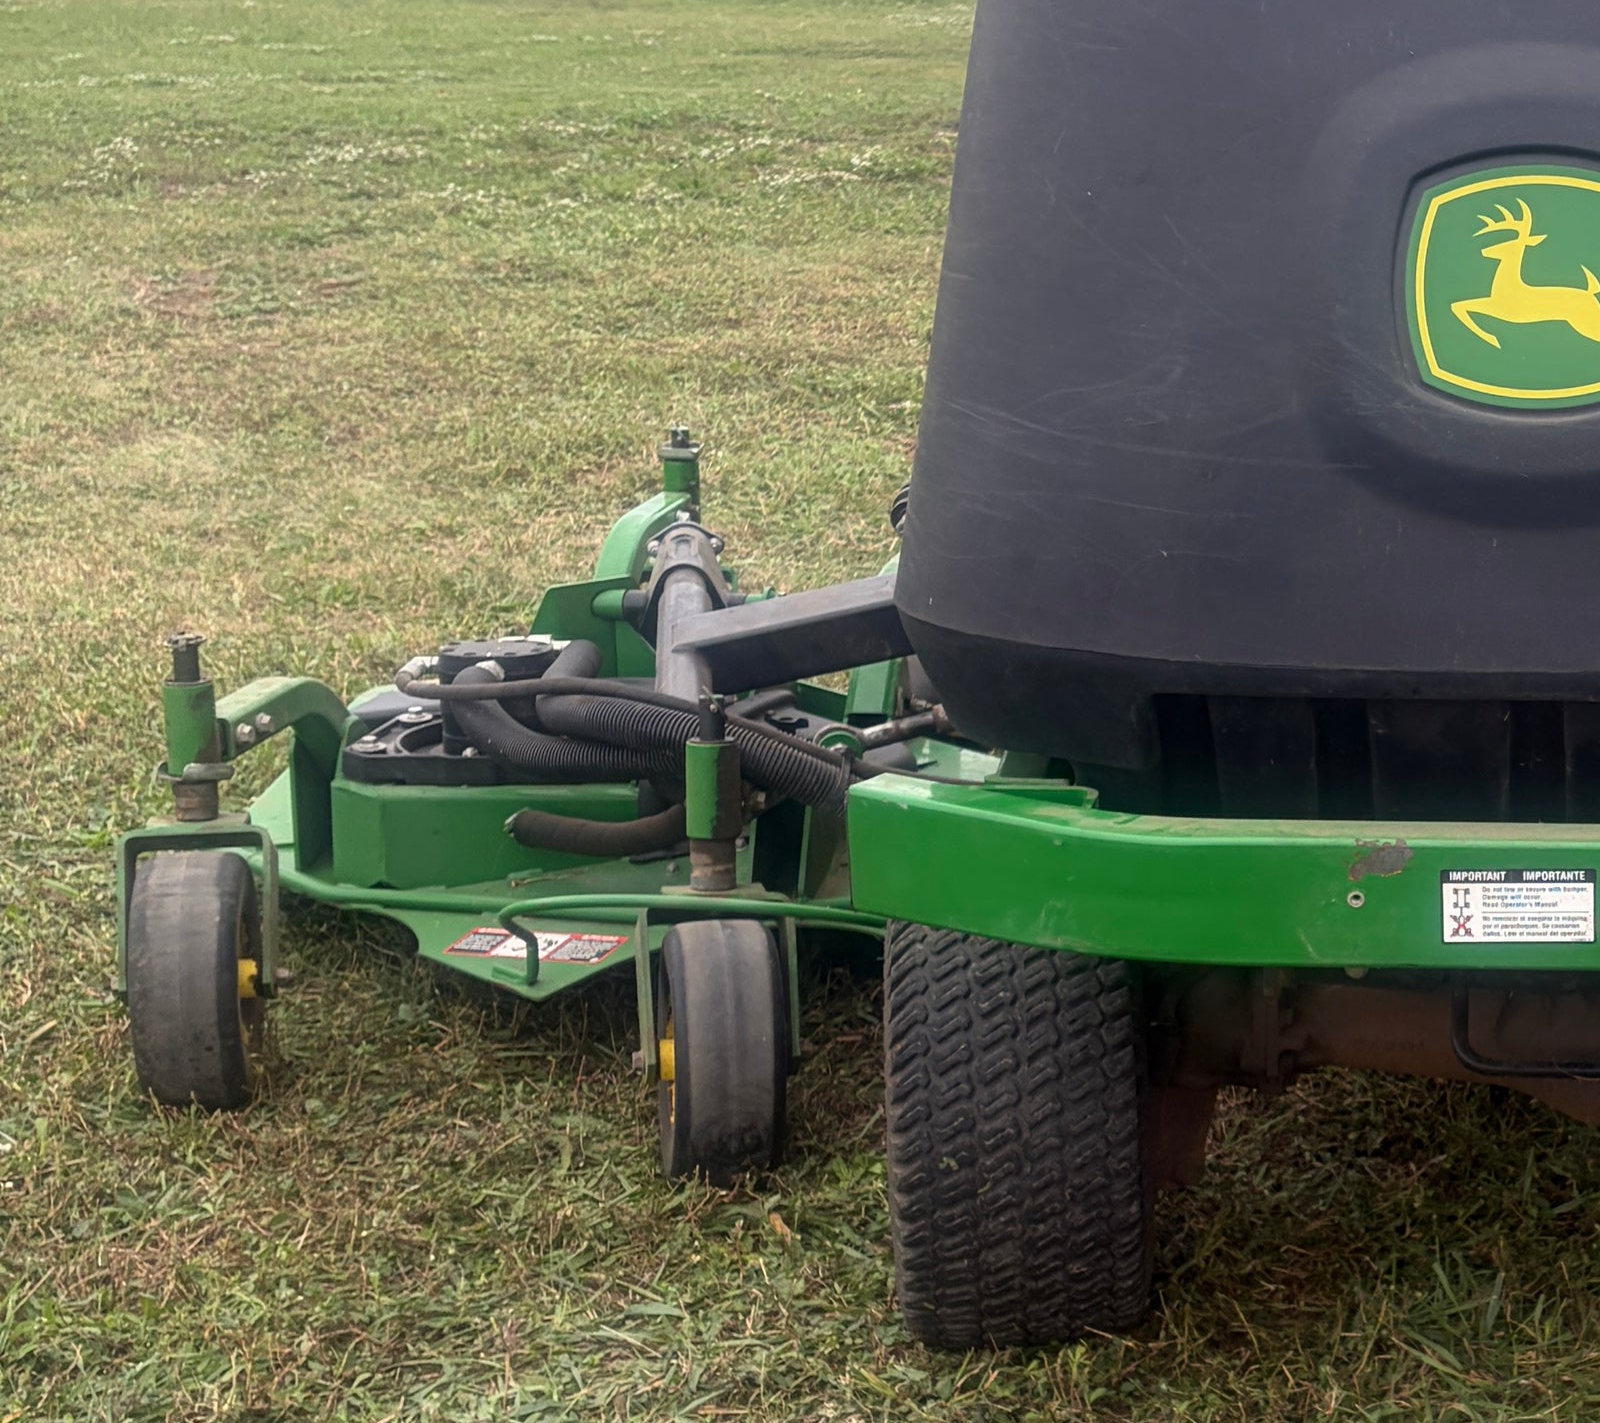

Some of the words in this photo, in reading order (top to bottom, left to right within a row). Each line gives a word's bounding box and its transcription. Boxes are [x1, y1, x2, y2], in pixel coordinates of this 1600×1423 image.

[1449, 871, 1507, 881] IMPORTANT
[1523, 870, 1586, 881] IMPORTANTE
[1500, 901, 1533, 909] Operator's
